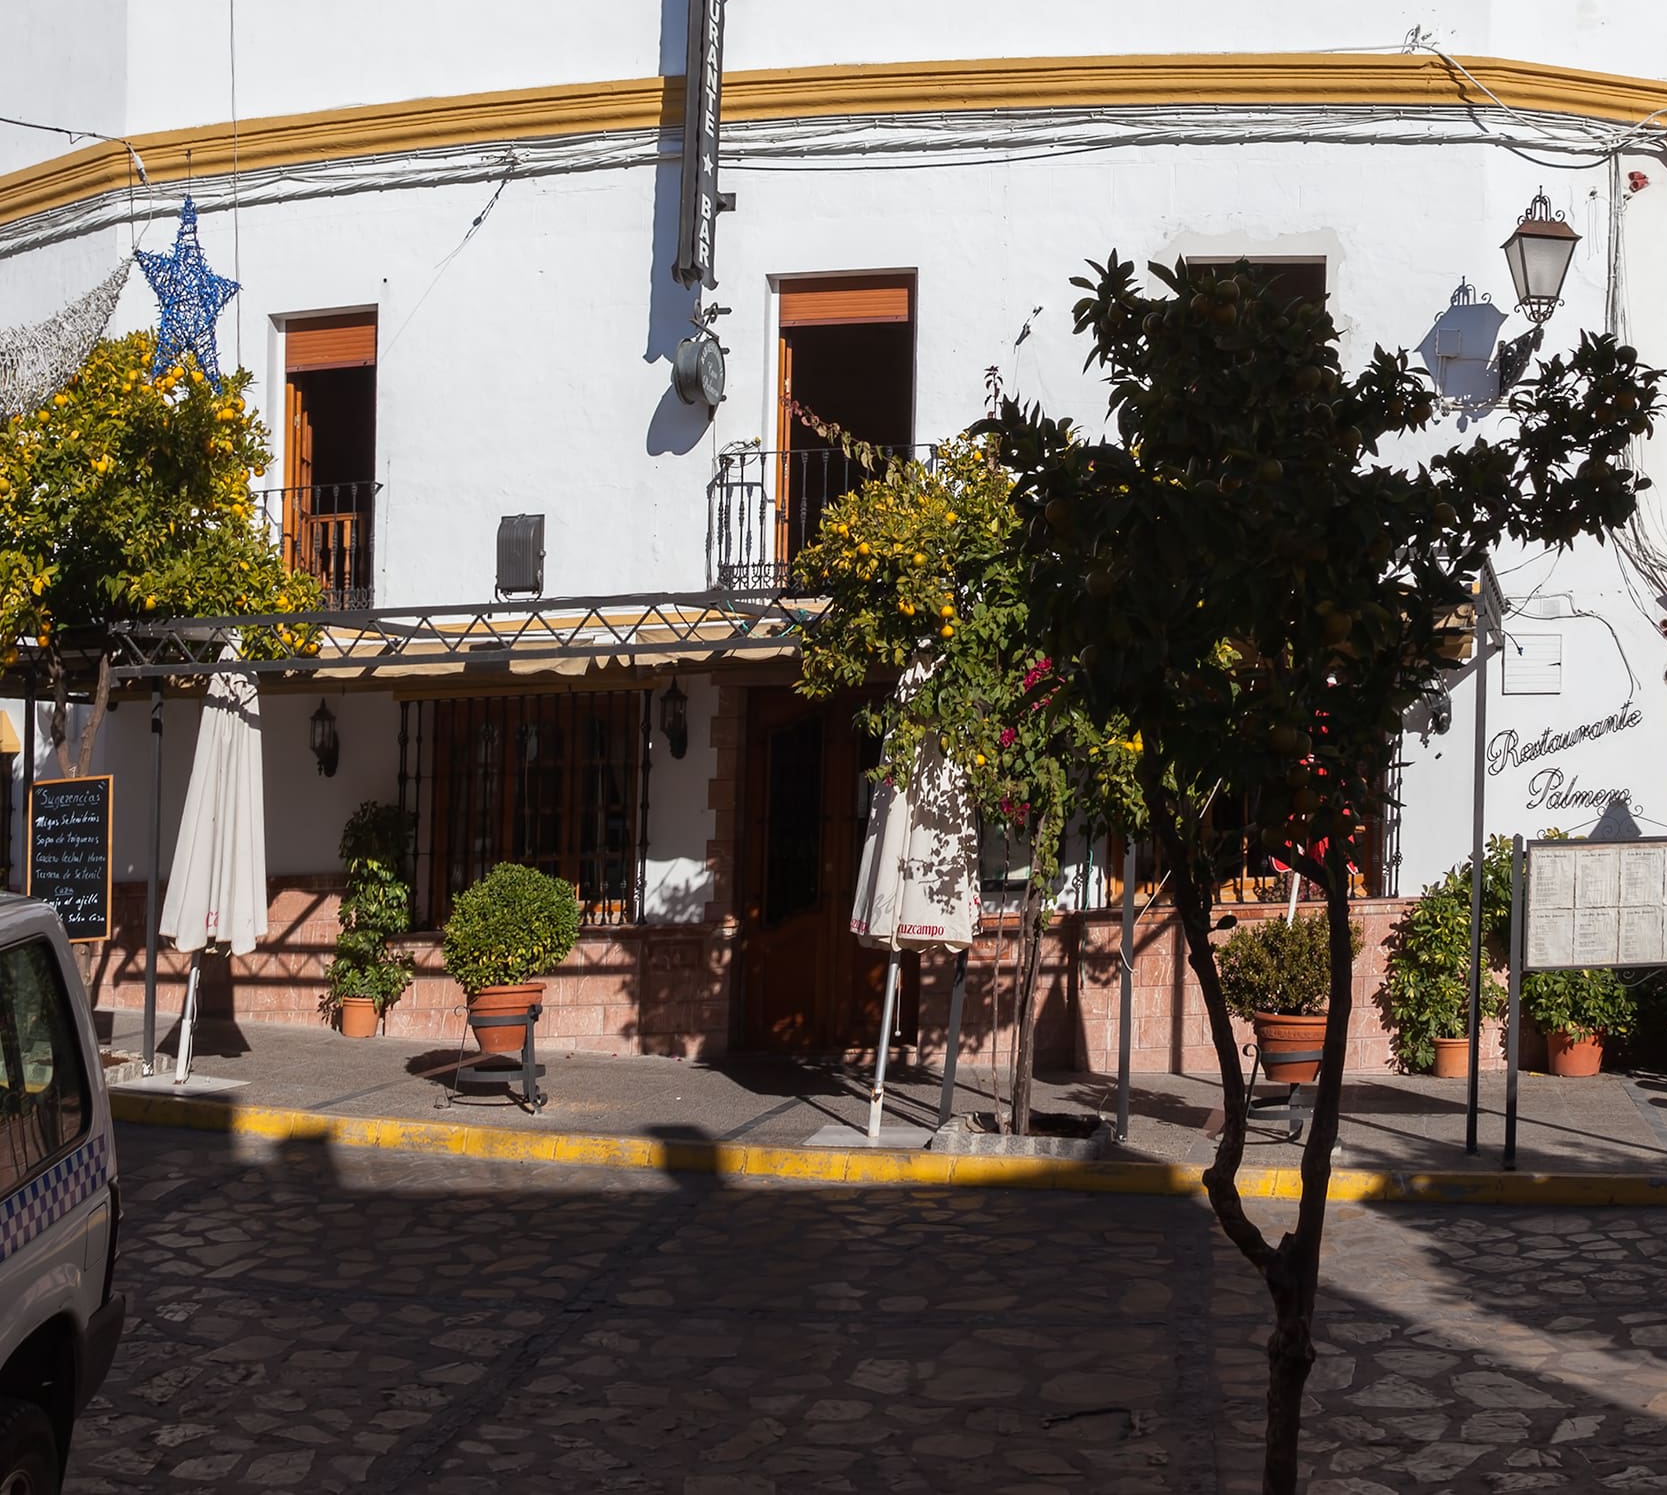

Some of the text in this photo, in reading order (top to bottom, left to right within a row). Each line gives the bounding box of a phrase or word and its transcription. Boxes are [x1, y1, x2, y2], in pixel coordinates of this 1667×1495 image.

[699, 193, 711, 268] BAR
[1487, 700, 1643, 776] Restaurante
[1526, 767, 1632, 809] Palmero
